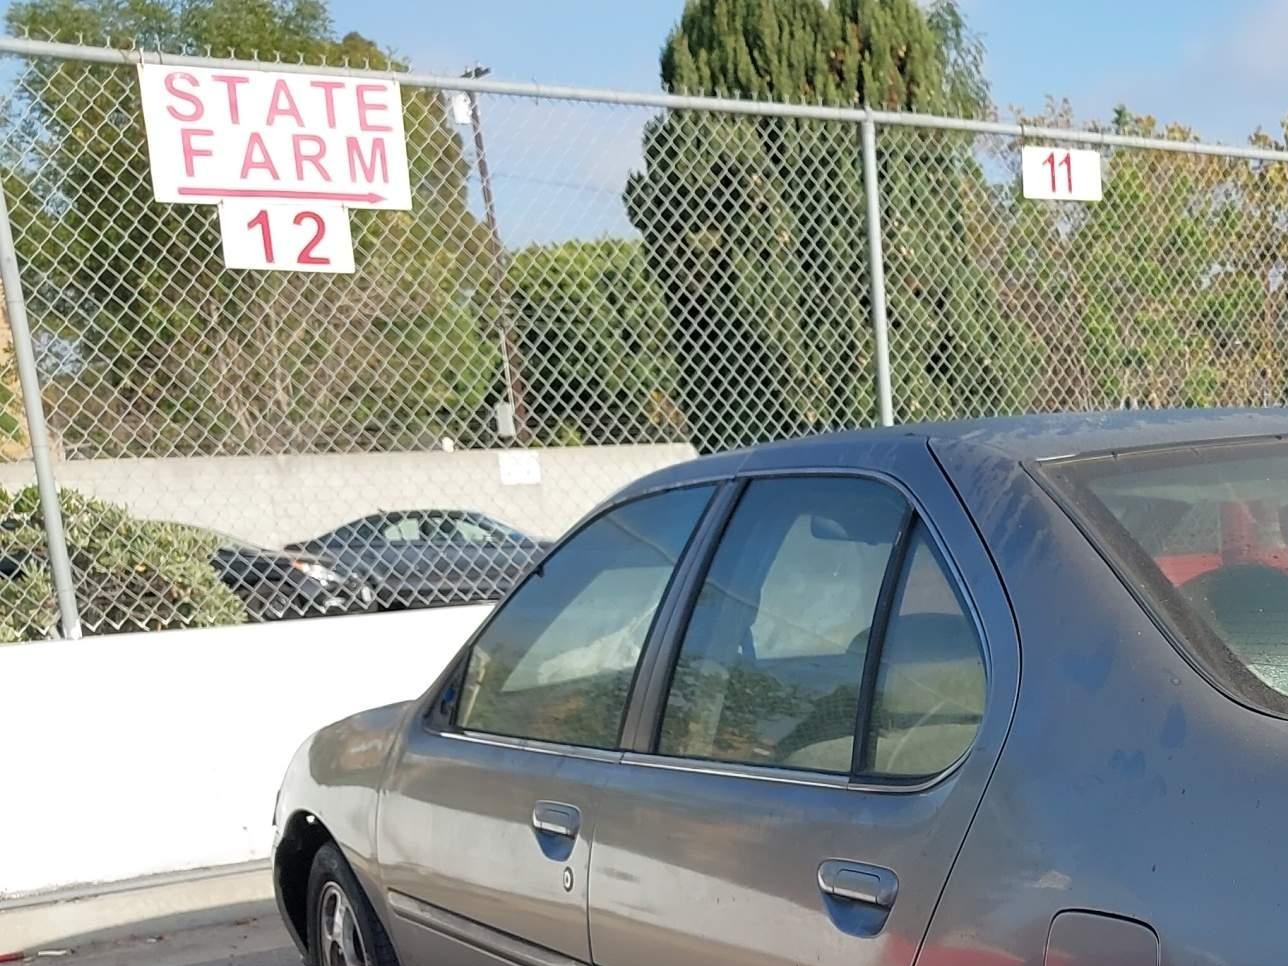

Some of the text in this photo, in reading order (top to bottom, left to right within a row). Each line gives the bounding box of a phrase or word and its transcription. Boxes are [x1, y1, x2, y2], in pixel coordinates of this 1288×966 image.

[164, 72, 393, 132] STATE
[180, 128, 389, 184] FARM
[1042, 151, 1073, 193] 11
[247, 209, 331, 265] 12
